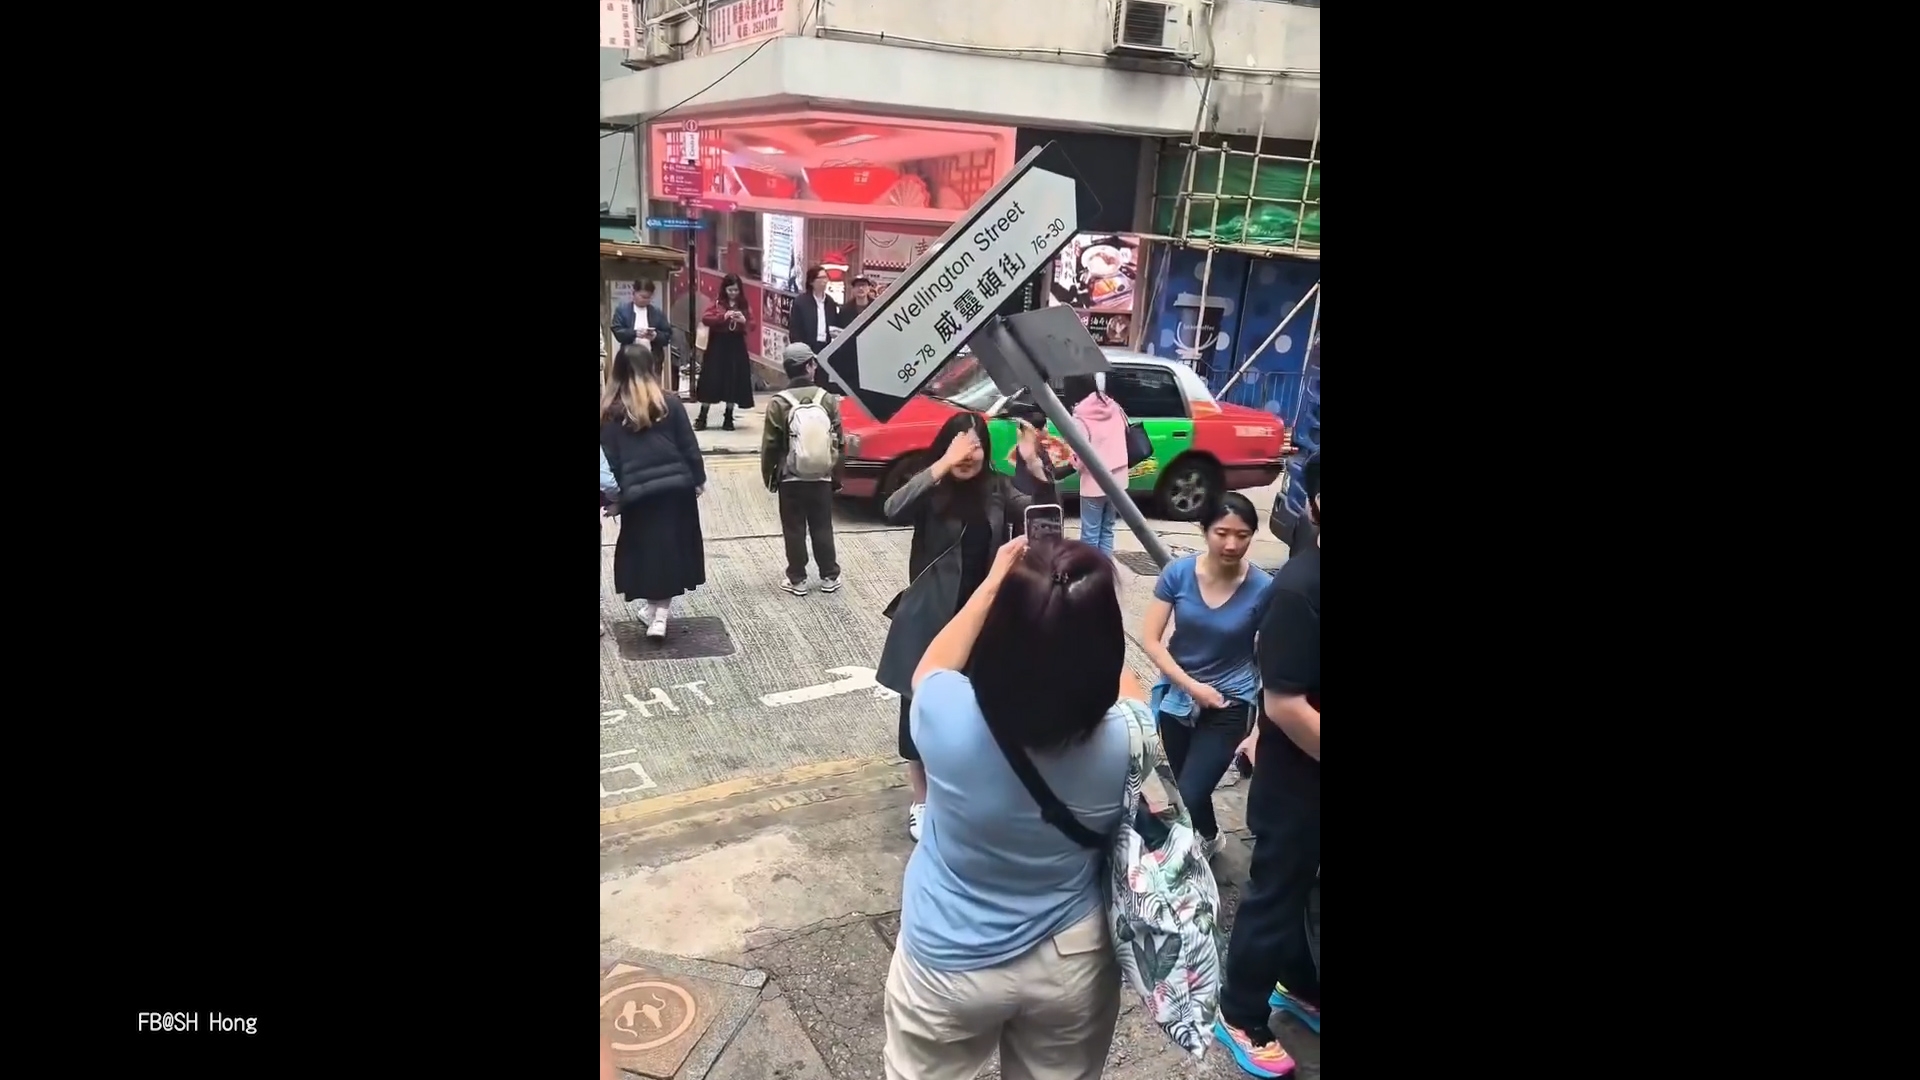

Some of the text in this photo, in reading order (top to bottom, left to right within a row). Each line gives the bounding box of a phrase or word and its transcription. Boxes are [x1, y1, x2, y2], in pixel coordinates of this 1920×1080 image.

[887, 251, 975, 333] Wellington
[974, 201, 1026, 252] Street
[1031, 218, 1065, 255] 76-30
[934, 252, 1026, 344] 威靈頓街
[897, 344, 936, 383] 98-78
